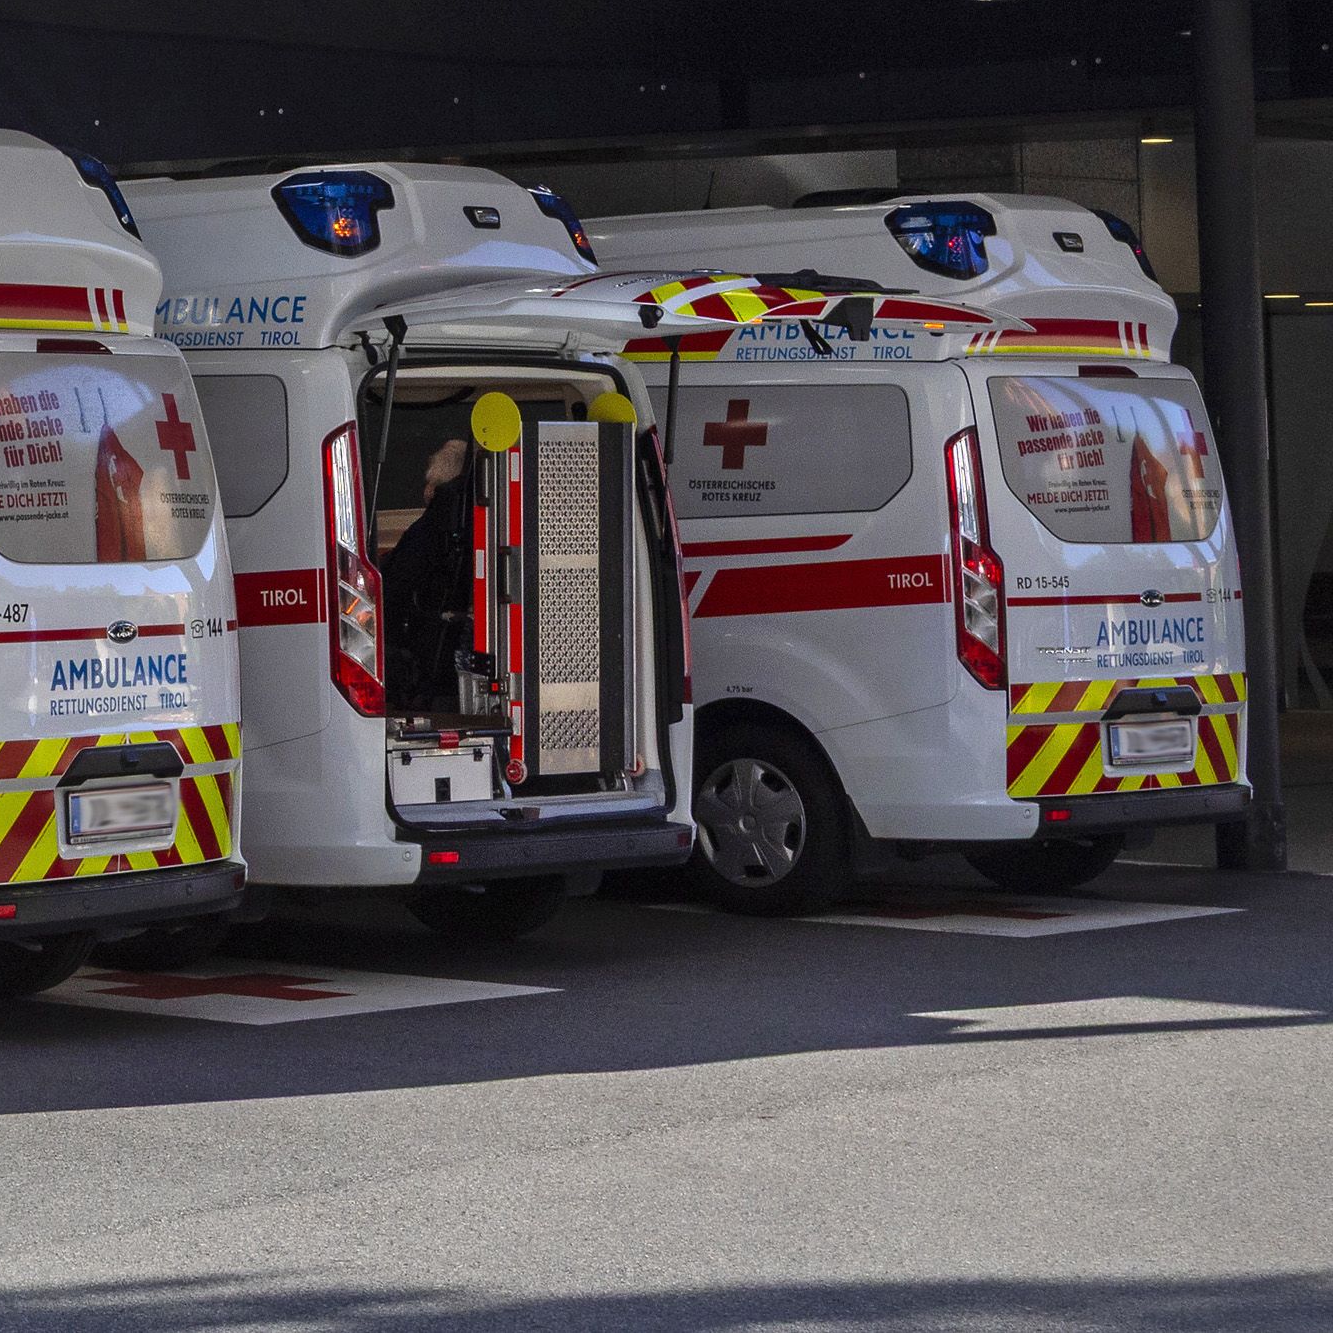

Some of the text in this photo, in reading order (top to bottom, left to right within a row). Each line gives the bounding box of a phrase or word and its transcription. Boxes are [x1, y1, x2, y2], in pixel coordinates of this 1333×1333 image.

[261, 331, 301, 346] TIROL
[873, 346, 913, 359] TIROL
[38, 390, 60, 411] die
[25, 415, 64, 439] Jacke
[1026, 415, 1048, 432] Wir
[1083, 408, 1100, 425] die
[3, 440, 63, 468] für Dich!
[1017, 433, 1073, 457] passende
[1075, 449, 1104, 468] Dich!
[689, 479, 776, 490] ÖSTERREICHISCHES
[7, 493, 34, 508] DICH
[36, 492, 68, 507] JETZT!
[702, 492, 761, 501] ROTES KREUZ
[1027, 489, 1109, 505] MELDE DICH JETZT!
[887, 572, 933, 589] TIROL
[1017, 576, 1070, 589] RD 15-545
[260, 588, 307, 607] TIROL
[1218, 588, 1231, 602] 144
[207, 618, 222, 637] 144
[1096, 617, 1204, 646] AMBULANCE
[1097, 651, 1173, 668] RETTUNGSDIENST
[1183, 649, 1205, 663] TIROL
[50, 654, 188, 691] AMBULANCE
[50, 692, 188, 716] RETTUNGSDIENST TIROL
